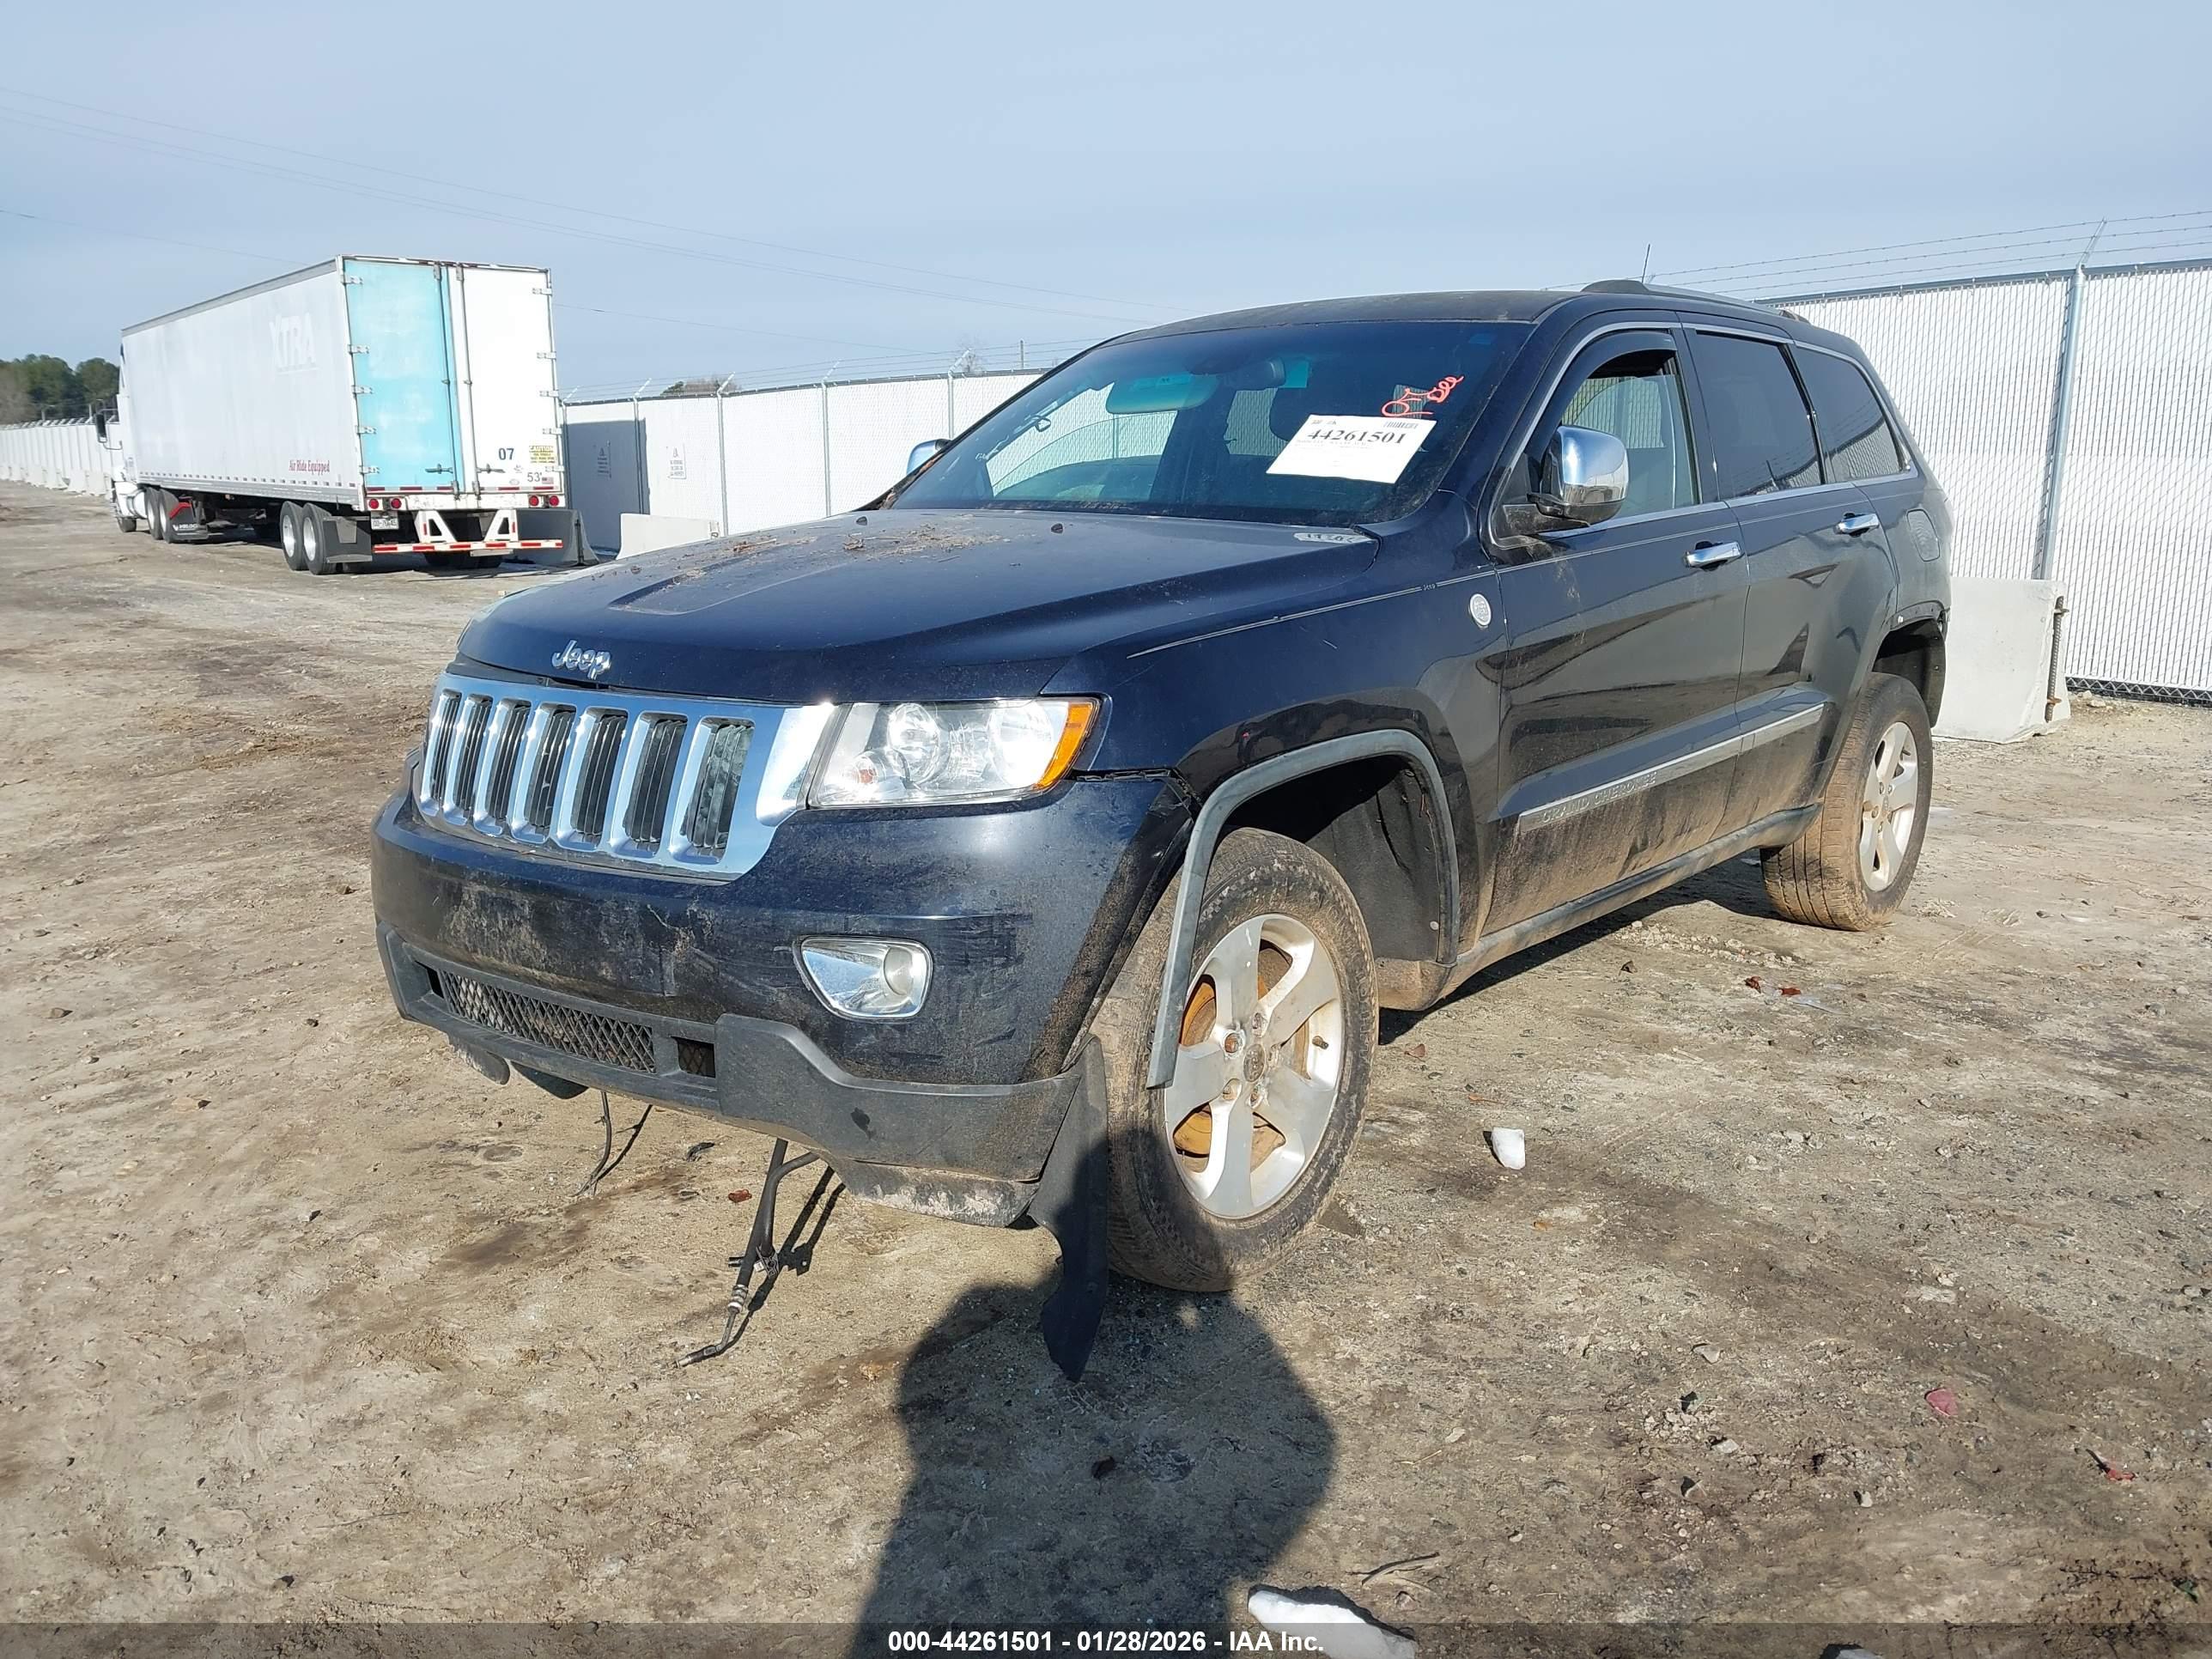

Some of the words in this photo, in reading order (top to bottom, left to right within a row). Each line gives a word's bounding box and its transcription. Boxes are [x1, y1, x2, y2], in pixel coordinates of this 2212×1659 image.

[268, 312, 316, 368] XTRA
[498, 447, 514, 460] 07
[1307, 428, 1407, 444] 44261501
[551, 639, 612, 681] Jeep
[1542, 797, 1589, 823] GRAND
[1594, 770, 1658, 805] CHEROKEE
